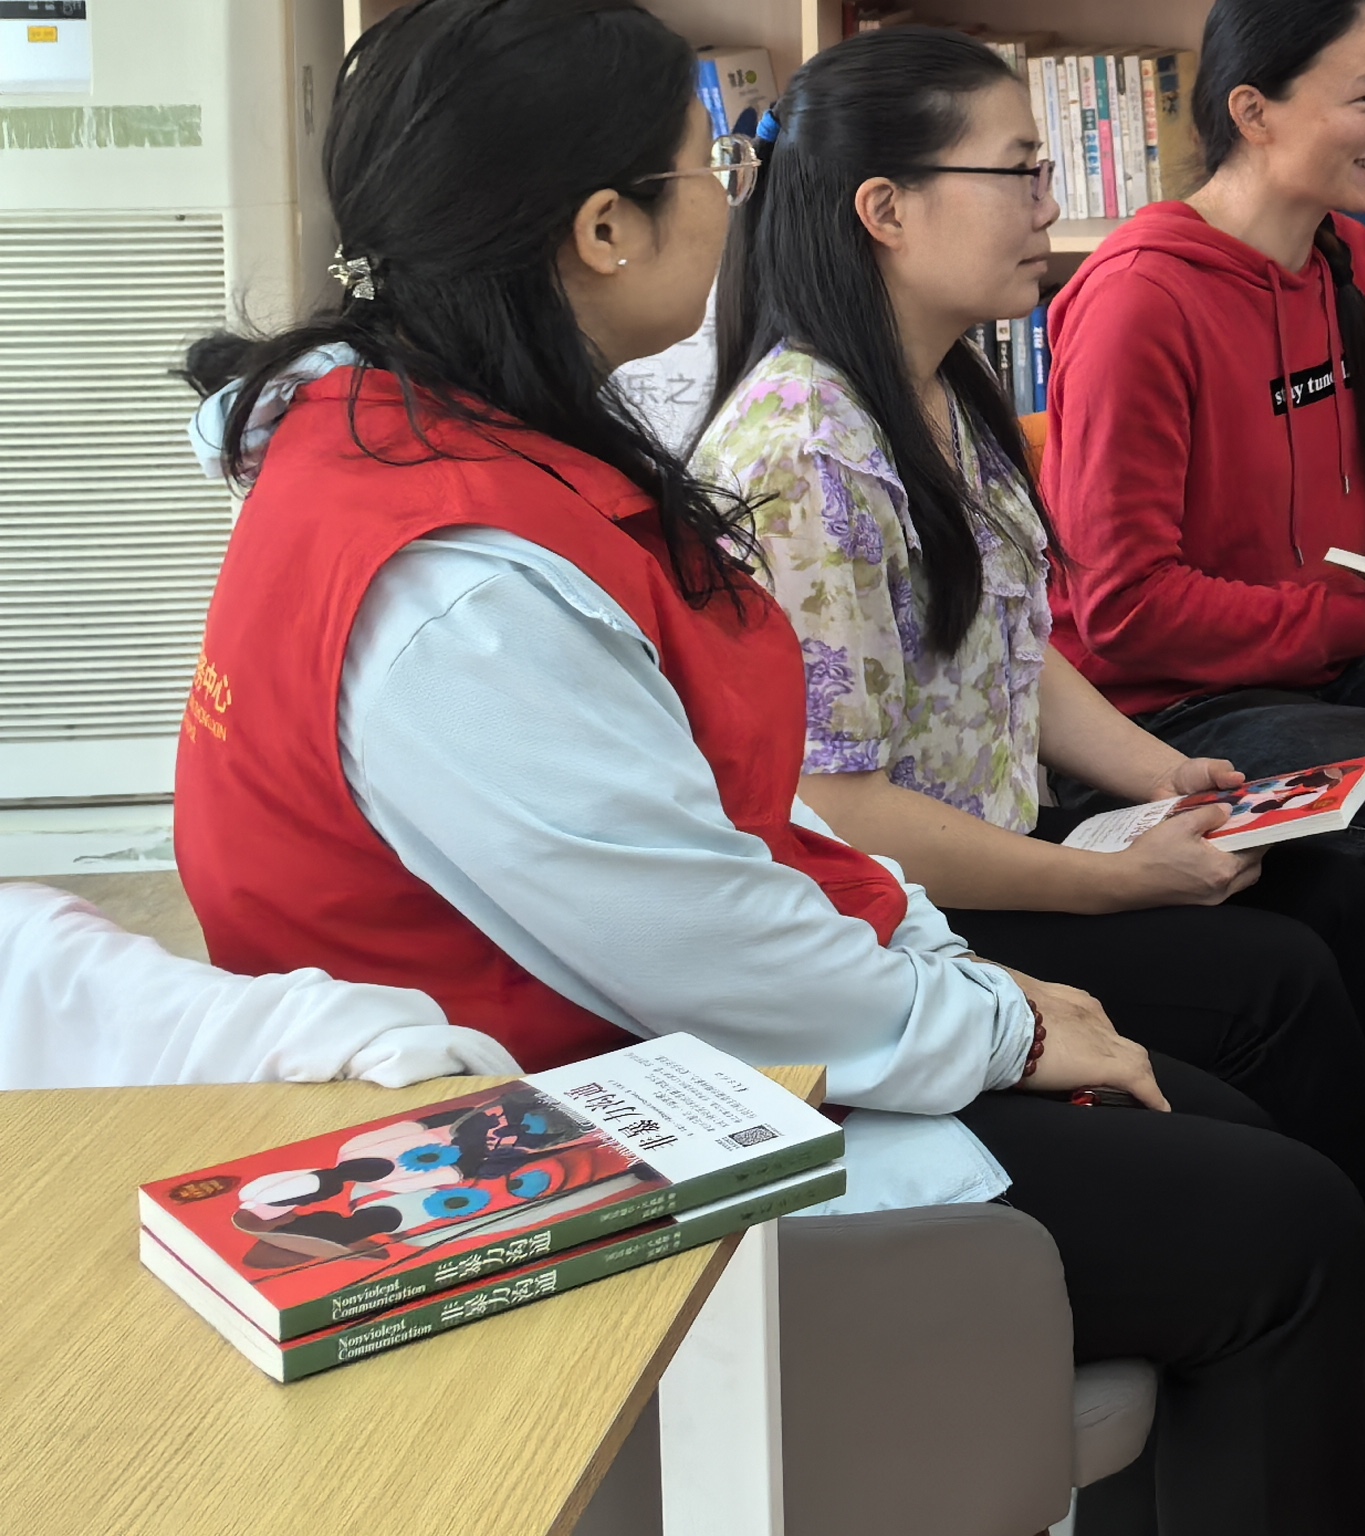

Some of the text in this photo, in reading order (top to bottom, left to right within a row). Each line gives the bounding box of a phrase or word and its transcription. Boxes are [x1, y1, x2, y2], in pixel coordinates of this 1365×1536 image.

[563, 1081, 679, 1151] 非暴力沟通
[435, 1230, 551, 1284] 非暴力沟通
[332, 1279, 400, 1310] Nonviolent
[332, 1285, 426, 1321] Communication
[441, 1269, 557, 1323] 非暴力沟通
[338, 1318, 406, 1350] Nonviolent
[338, 1323, 432, 1361] Communication
